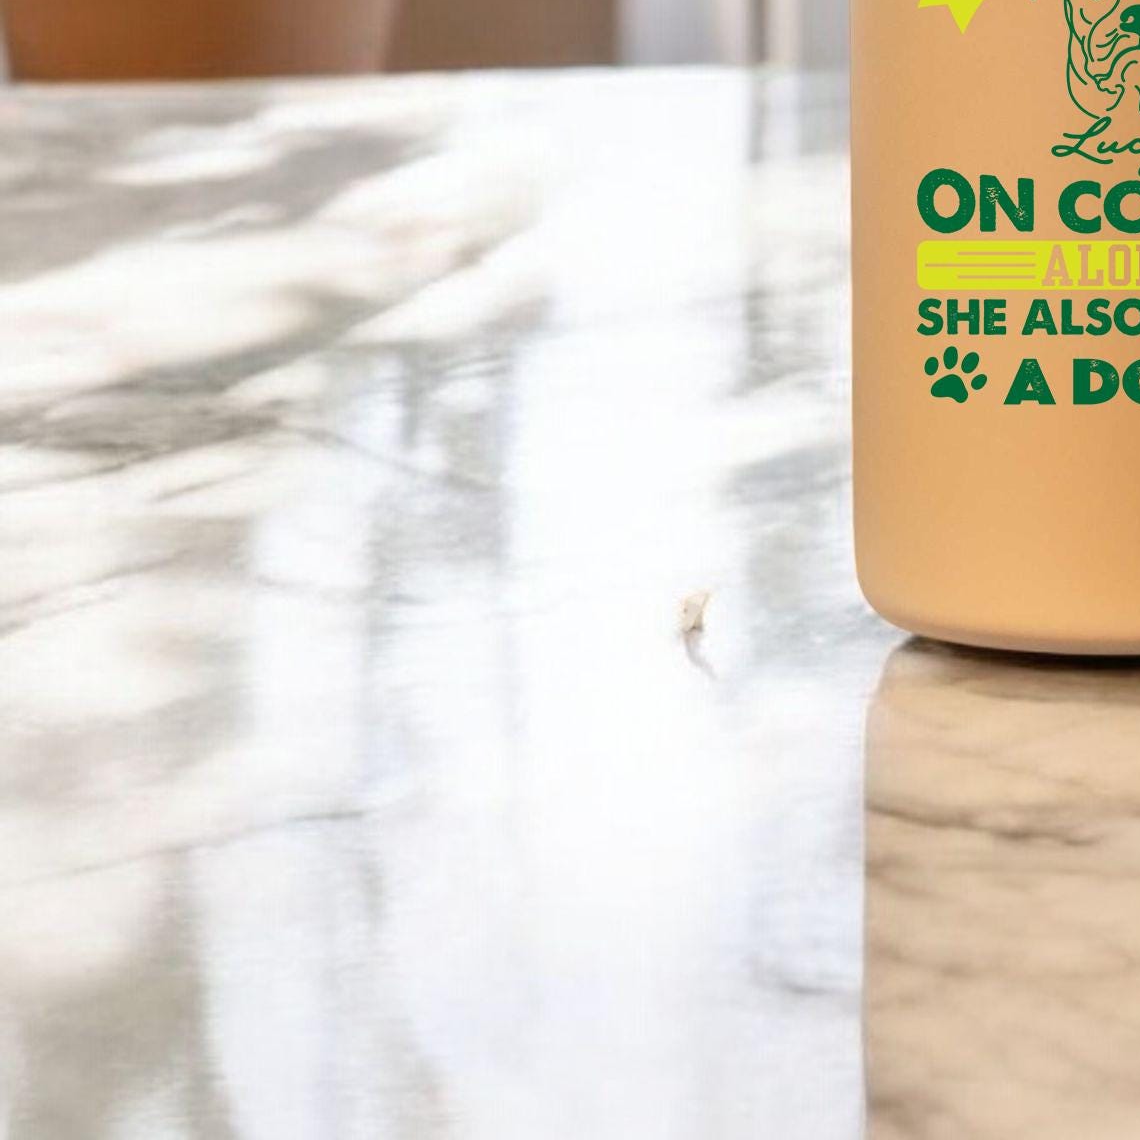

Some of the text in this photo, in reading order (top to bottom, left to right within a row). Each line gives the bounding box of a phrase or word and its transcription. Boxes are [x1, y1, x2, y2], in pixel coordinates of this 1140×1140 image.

[917, 168, 1035, 234] ON
[917, 298, 1007, 336] SHE
[1003, 358, 1057, 405] A
